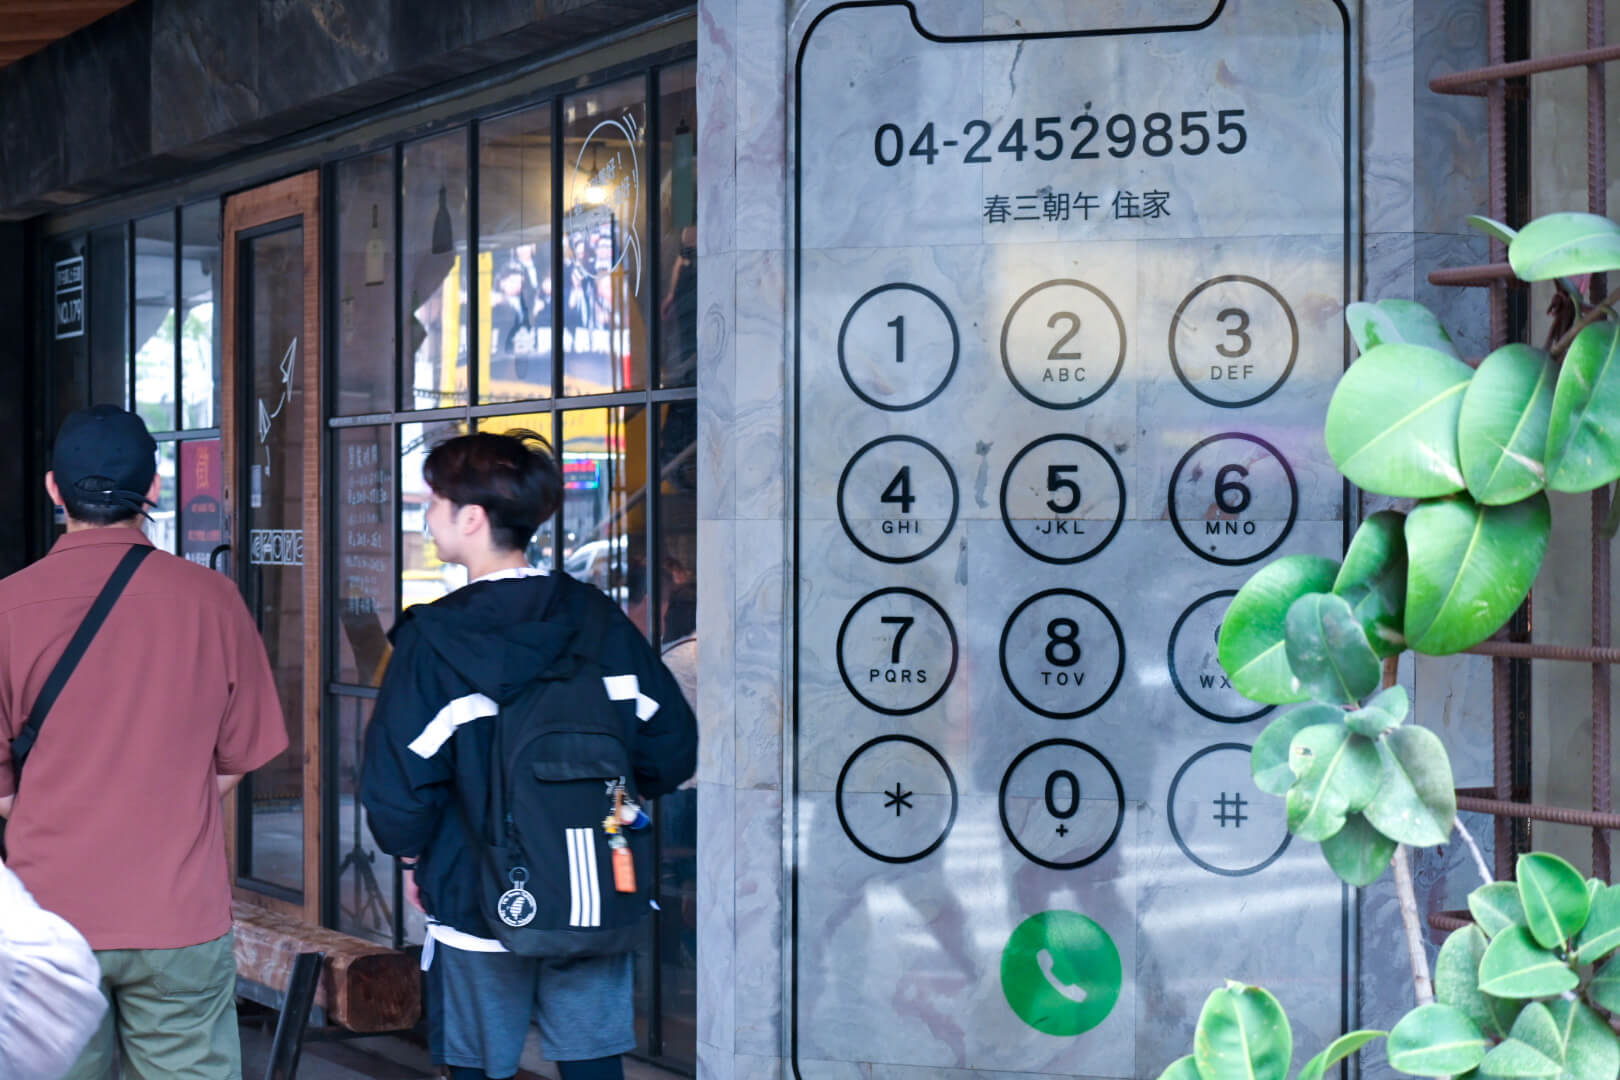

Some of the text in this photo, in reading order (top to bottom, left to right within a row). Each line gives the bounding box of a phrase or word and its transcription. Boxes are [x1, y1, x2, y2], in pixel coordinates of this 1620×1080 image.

[874, 108, 1248, 168] 04-24529855
[983, 188, 1171, 224] 春三朝午 住家
[886, 315, 905, 363] 1
[1047, 311, 1083, 361] 2
[1215, 307, 1252, 359] 3
[1042, 367, 1086, 383] ABC
[1210, 364, 1255, 381] DEF
[880, 465, 916, 514] 4
[1046, 464, 1082, 515] 5
[1214, 464, 1252, 516] 6
[881, 518, 919, 535] GHI
[1041, 518, 1085, 535] JKL
[1205, 519, 1256, 536] MNO
[880, 616, 914, 664] 7
[1045, 617, 1082, 668] 8
[869, 669, 928, 684] PQRS
[1040, 671, 1085, 687] TOV
[1045, 769, 1081, 819] 0
